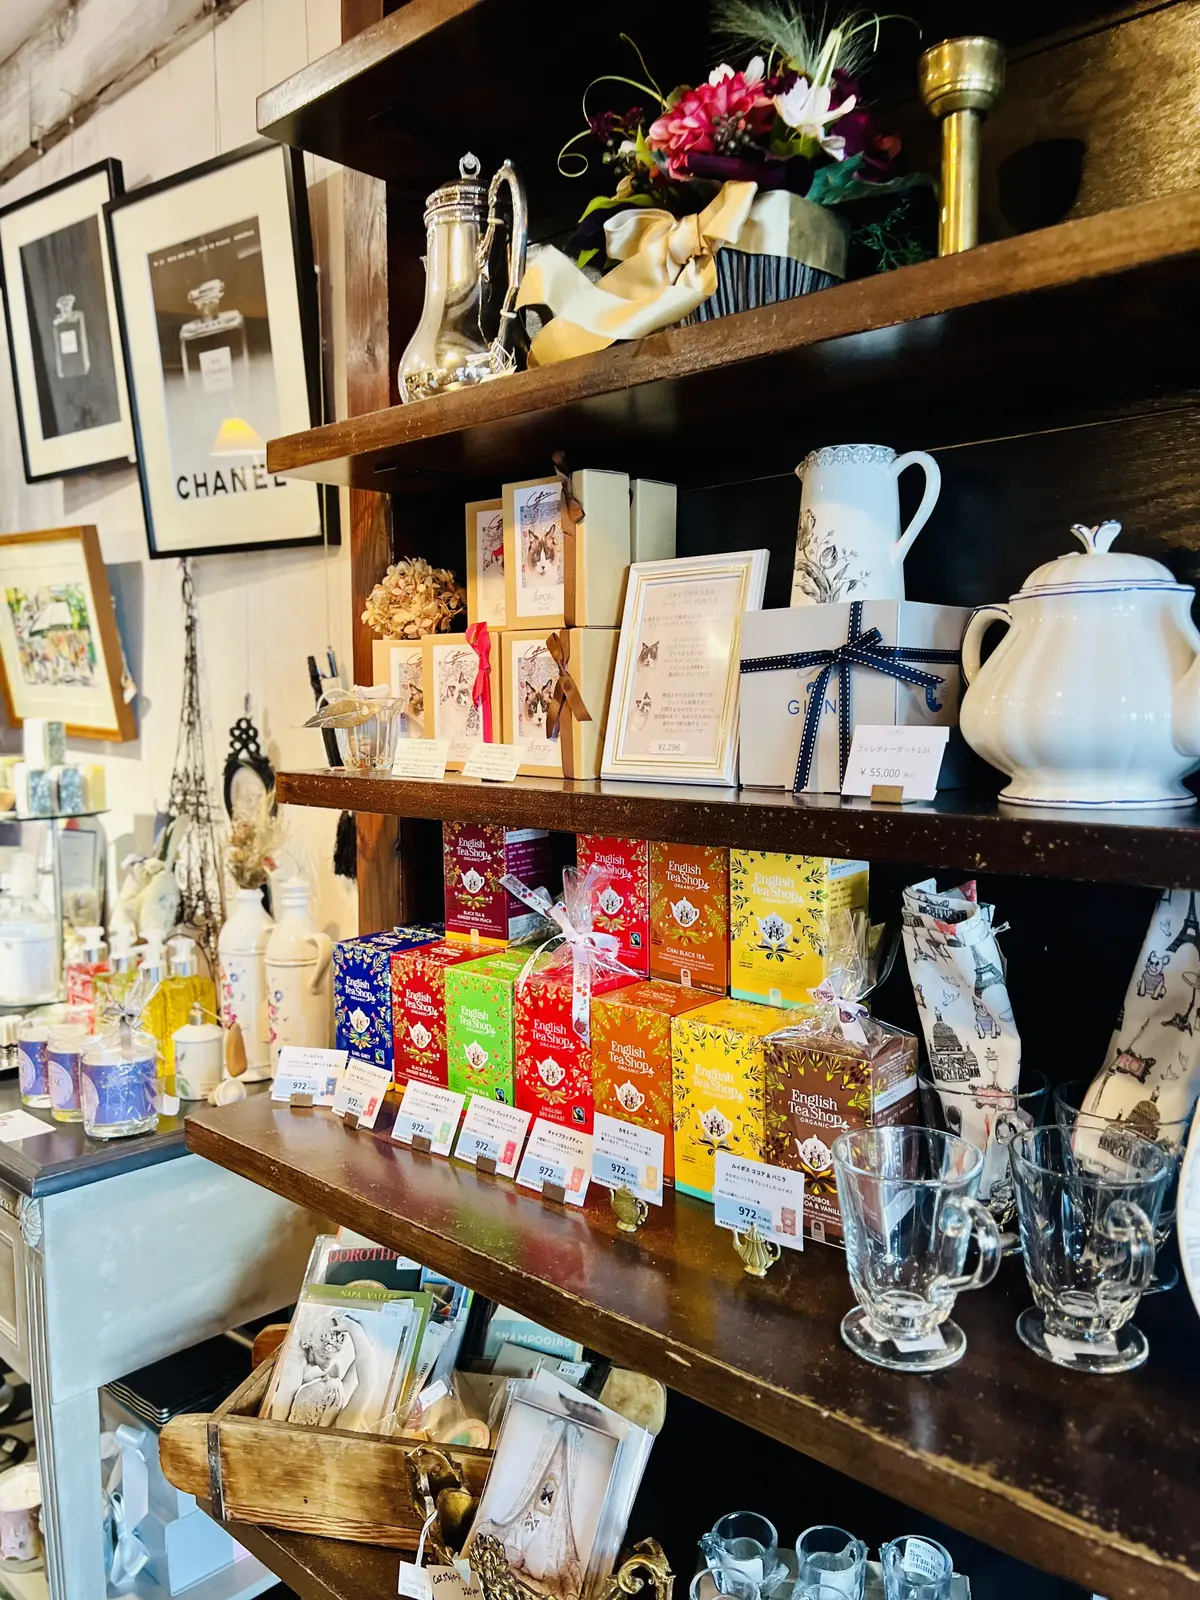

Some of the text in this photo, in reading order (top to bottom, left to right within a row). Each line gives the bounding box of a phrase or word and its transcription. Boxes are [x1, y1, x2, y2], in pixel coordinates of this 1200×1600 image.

[787, 699, 837, 715] GIN
[870, 767, 901, 779] 55,000
[458, 837, 486, 850] English
[595, 852, 625, 867] English
[668, 860, 702, 878] English
[754, 872, 796, 890] English
[666, 946, 706, 961] CHAI BLACK TEA
[345, 976, 370, 991] English
[406, 989, 432, 1006] English
[460, 1005, 489, 1022] English
[533, 1019, 567, 1037] English
[611, 1040, 646, 1060] English
[694, 1063, 735, 1087] English
[292, 1081, 307, 1090] 972
[347, 1096, 358, 1107] 972
[791, 1088, 839, 1111] English
[538, 1110, 565, 1123] BREAKFAST
[541, 1104, 562, 1115] ENGLISH
[411, 1122, 424, 1133] 972
[799, 1117, 830, 1129] ORGANIC
[475, 1140, 489, 1152] 972
[538, 1165, 554, 1178] 972
[611, 1162, 626, 1175] 972
[732, 1163, 750, 1173] ルイボス
[751, 1168, 765, 1177] ココア
[771, 1174, 787, 1183] バニラ
[738, 1206, 757, 1220] 972
[340, 1290, 361, 1299] NAPA
[495, 1330, 574, 1349] SHAMPOOING
